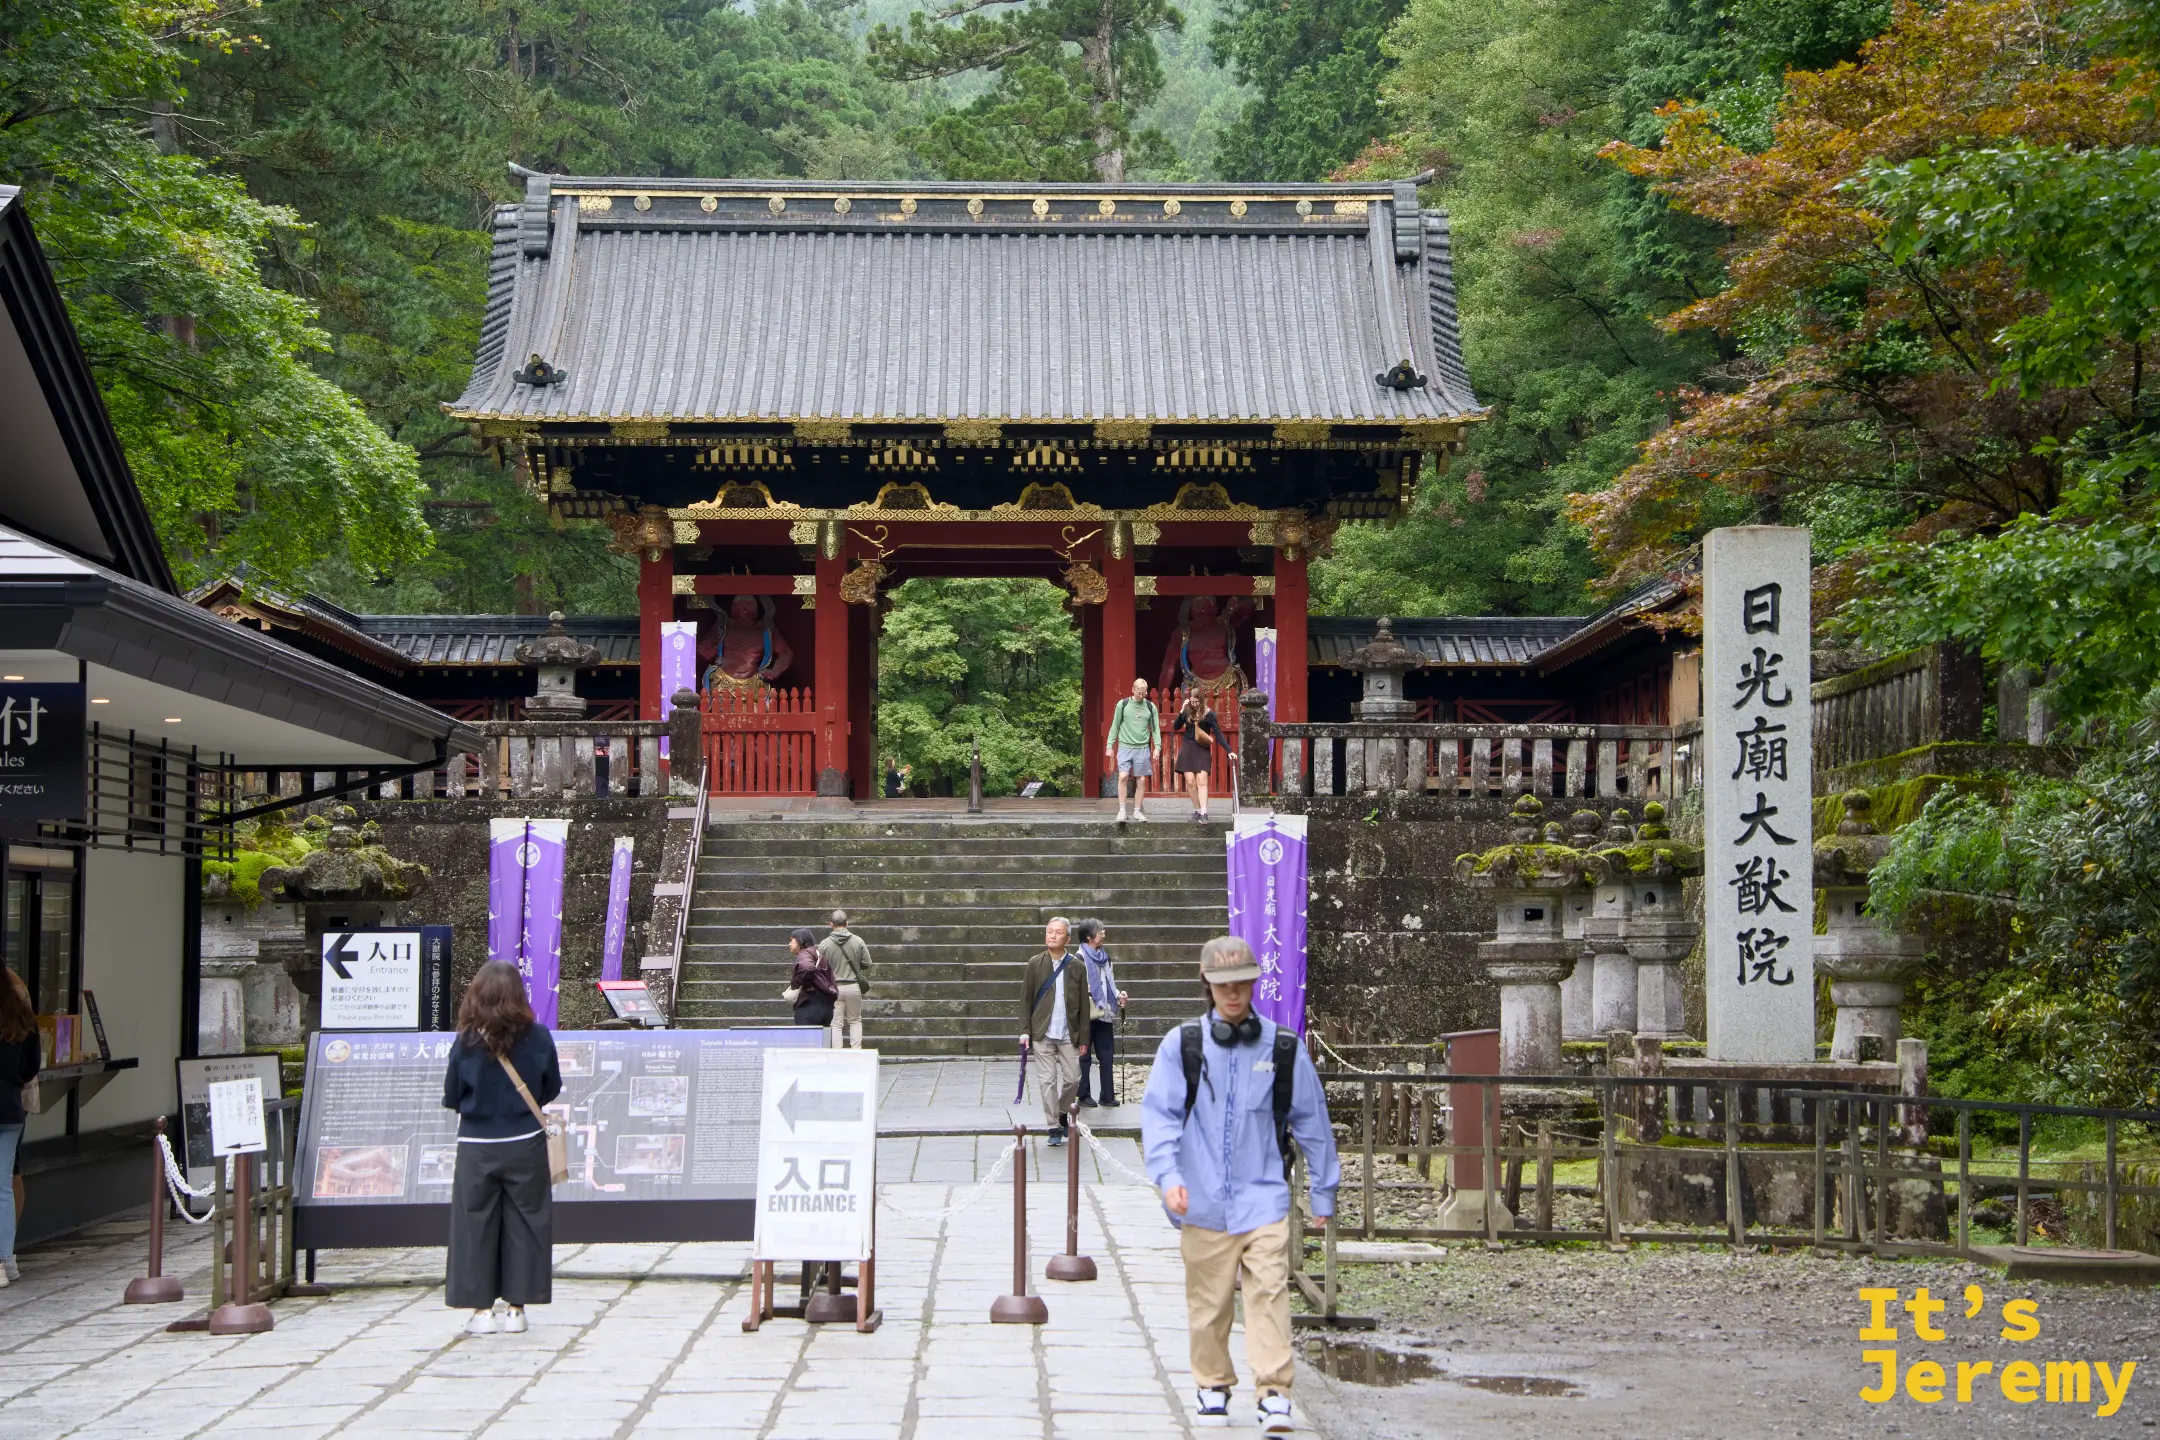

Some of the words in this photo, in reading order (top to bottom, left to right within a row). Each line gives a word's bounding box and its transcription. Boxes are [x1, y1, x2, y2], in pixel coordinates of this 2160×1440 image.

[0, 696, 48, 746] 付
[1729, 582, 1799, 987] 日光廟大猷院
[367, 941, 412, 962] 入口
[1259, 875, 1283, 1002] 日光廟大猷院
[370, 966, 409, 974] Entrance
[774, 1157, 852, 1192] 入口
[768, 1194, 857, 1213] ENTRANCE
